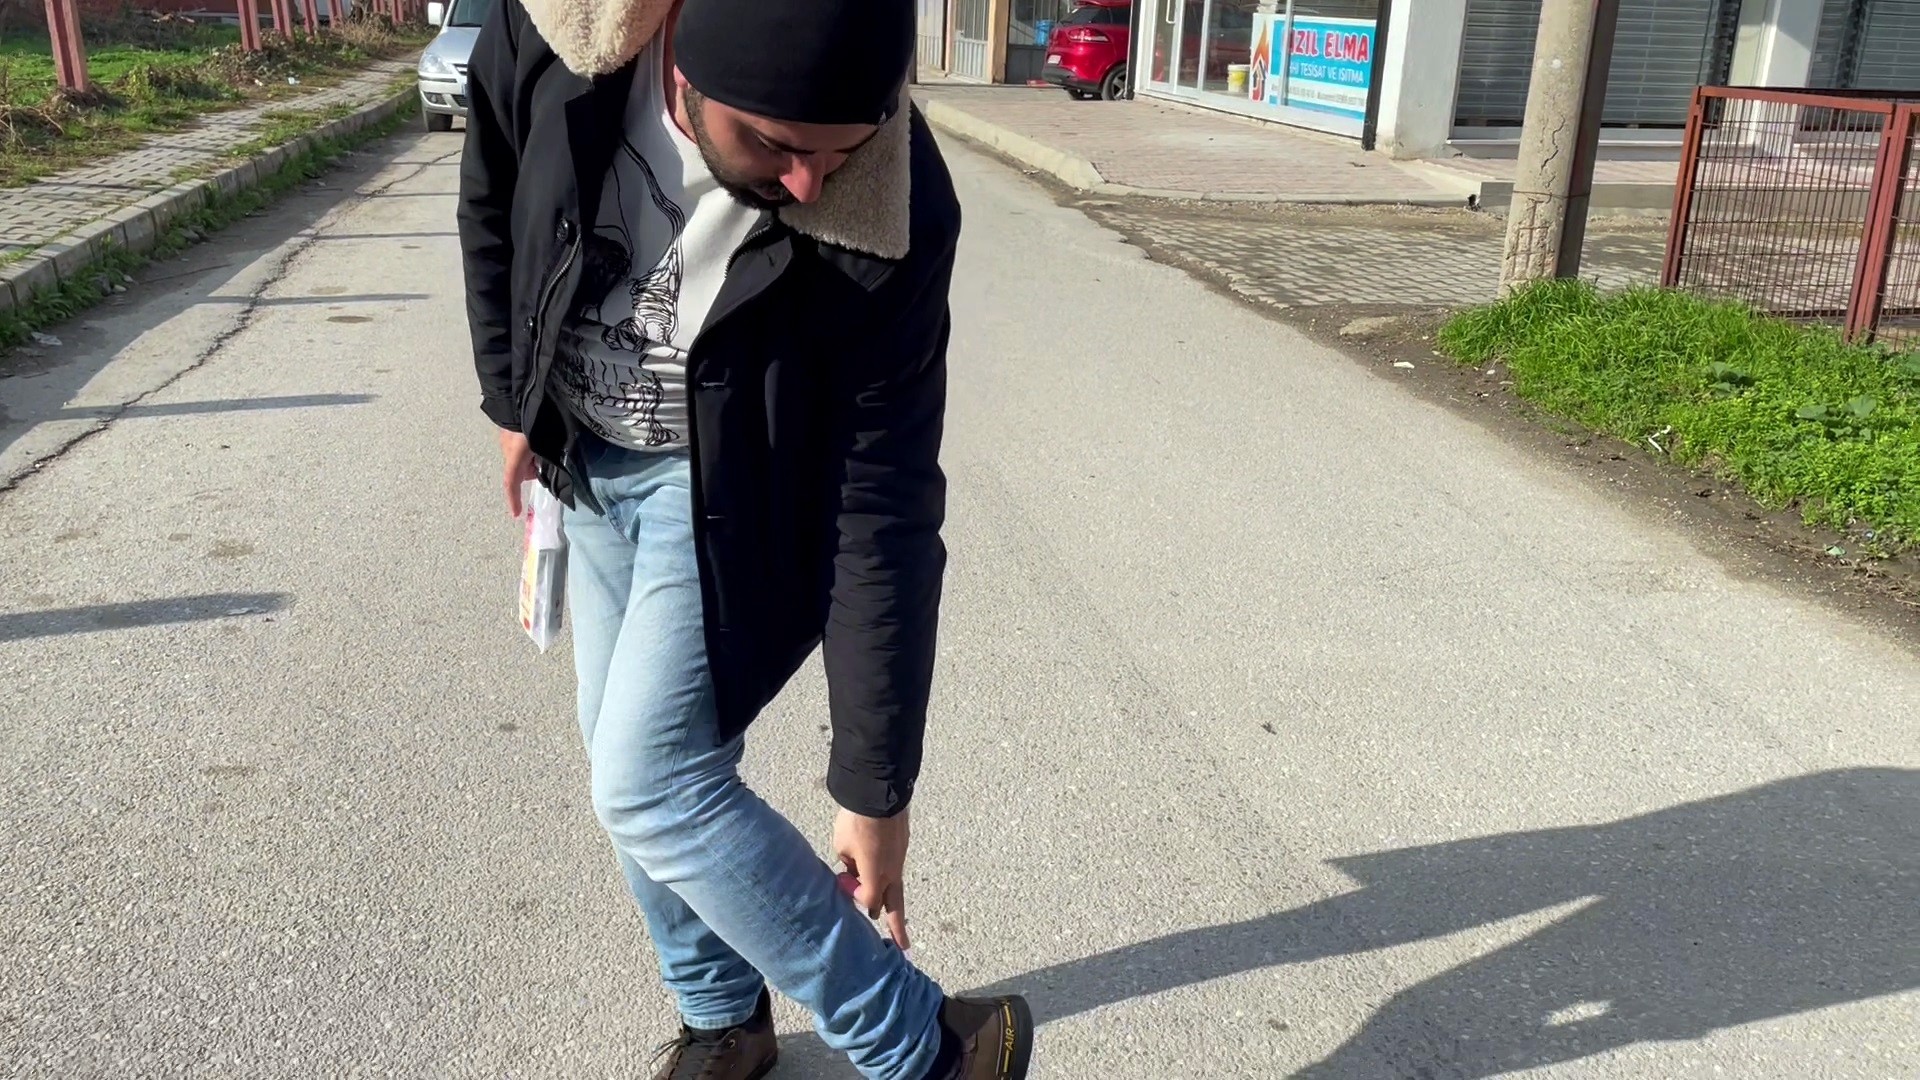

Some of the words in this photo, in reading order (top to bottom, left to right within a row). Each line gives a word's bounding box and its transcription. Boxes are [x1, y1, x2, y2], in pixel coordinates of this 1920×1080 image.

[1289, 29, 1318, 56] IZIL
[1325, 32, 1369, 63] ELMA
[1327, 65, 1337, 80] VE
[1005, 1027, 1015, 1051] AIR
